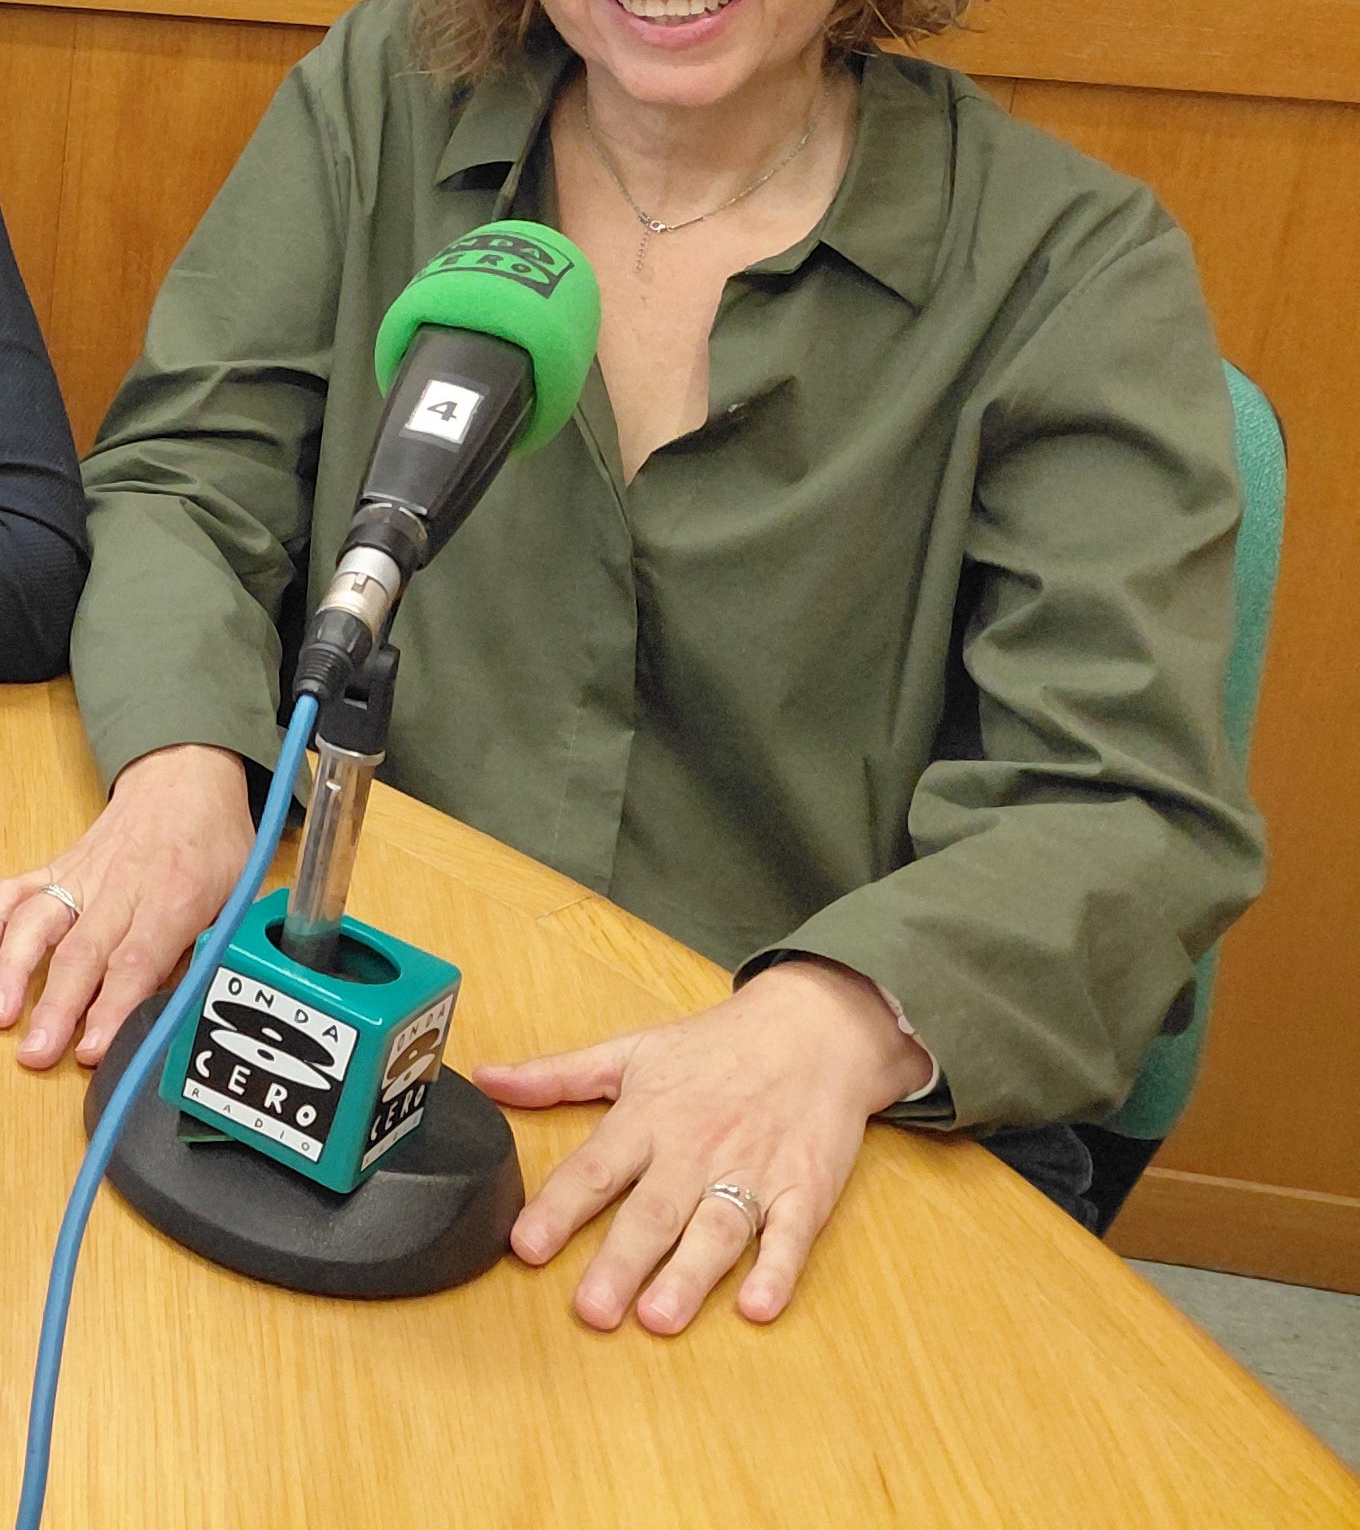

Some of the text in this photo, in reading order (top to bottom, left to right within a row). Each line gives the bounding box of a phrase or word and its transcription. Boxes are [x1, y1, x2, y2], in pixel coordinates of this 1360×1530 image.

[427, 401, 458, 422] 4
[228, 976, 340, 1044] ONDA
[397, 1003, 447, 1053] ONDA
[195, 1050, 318, 1128] CERO
[370, 1084, 426, 1141] CERO
[191, 1088, 311, 1153] RADIO
